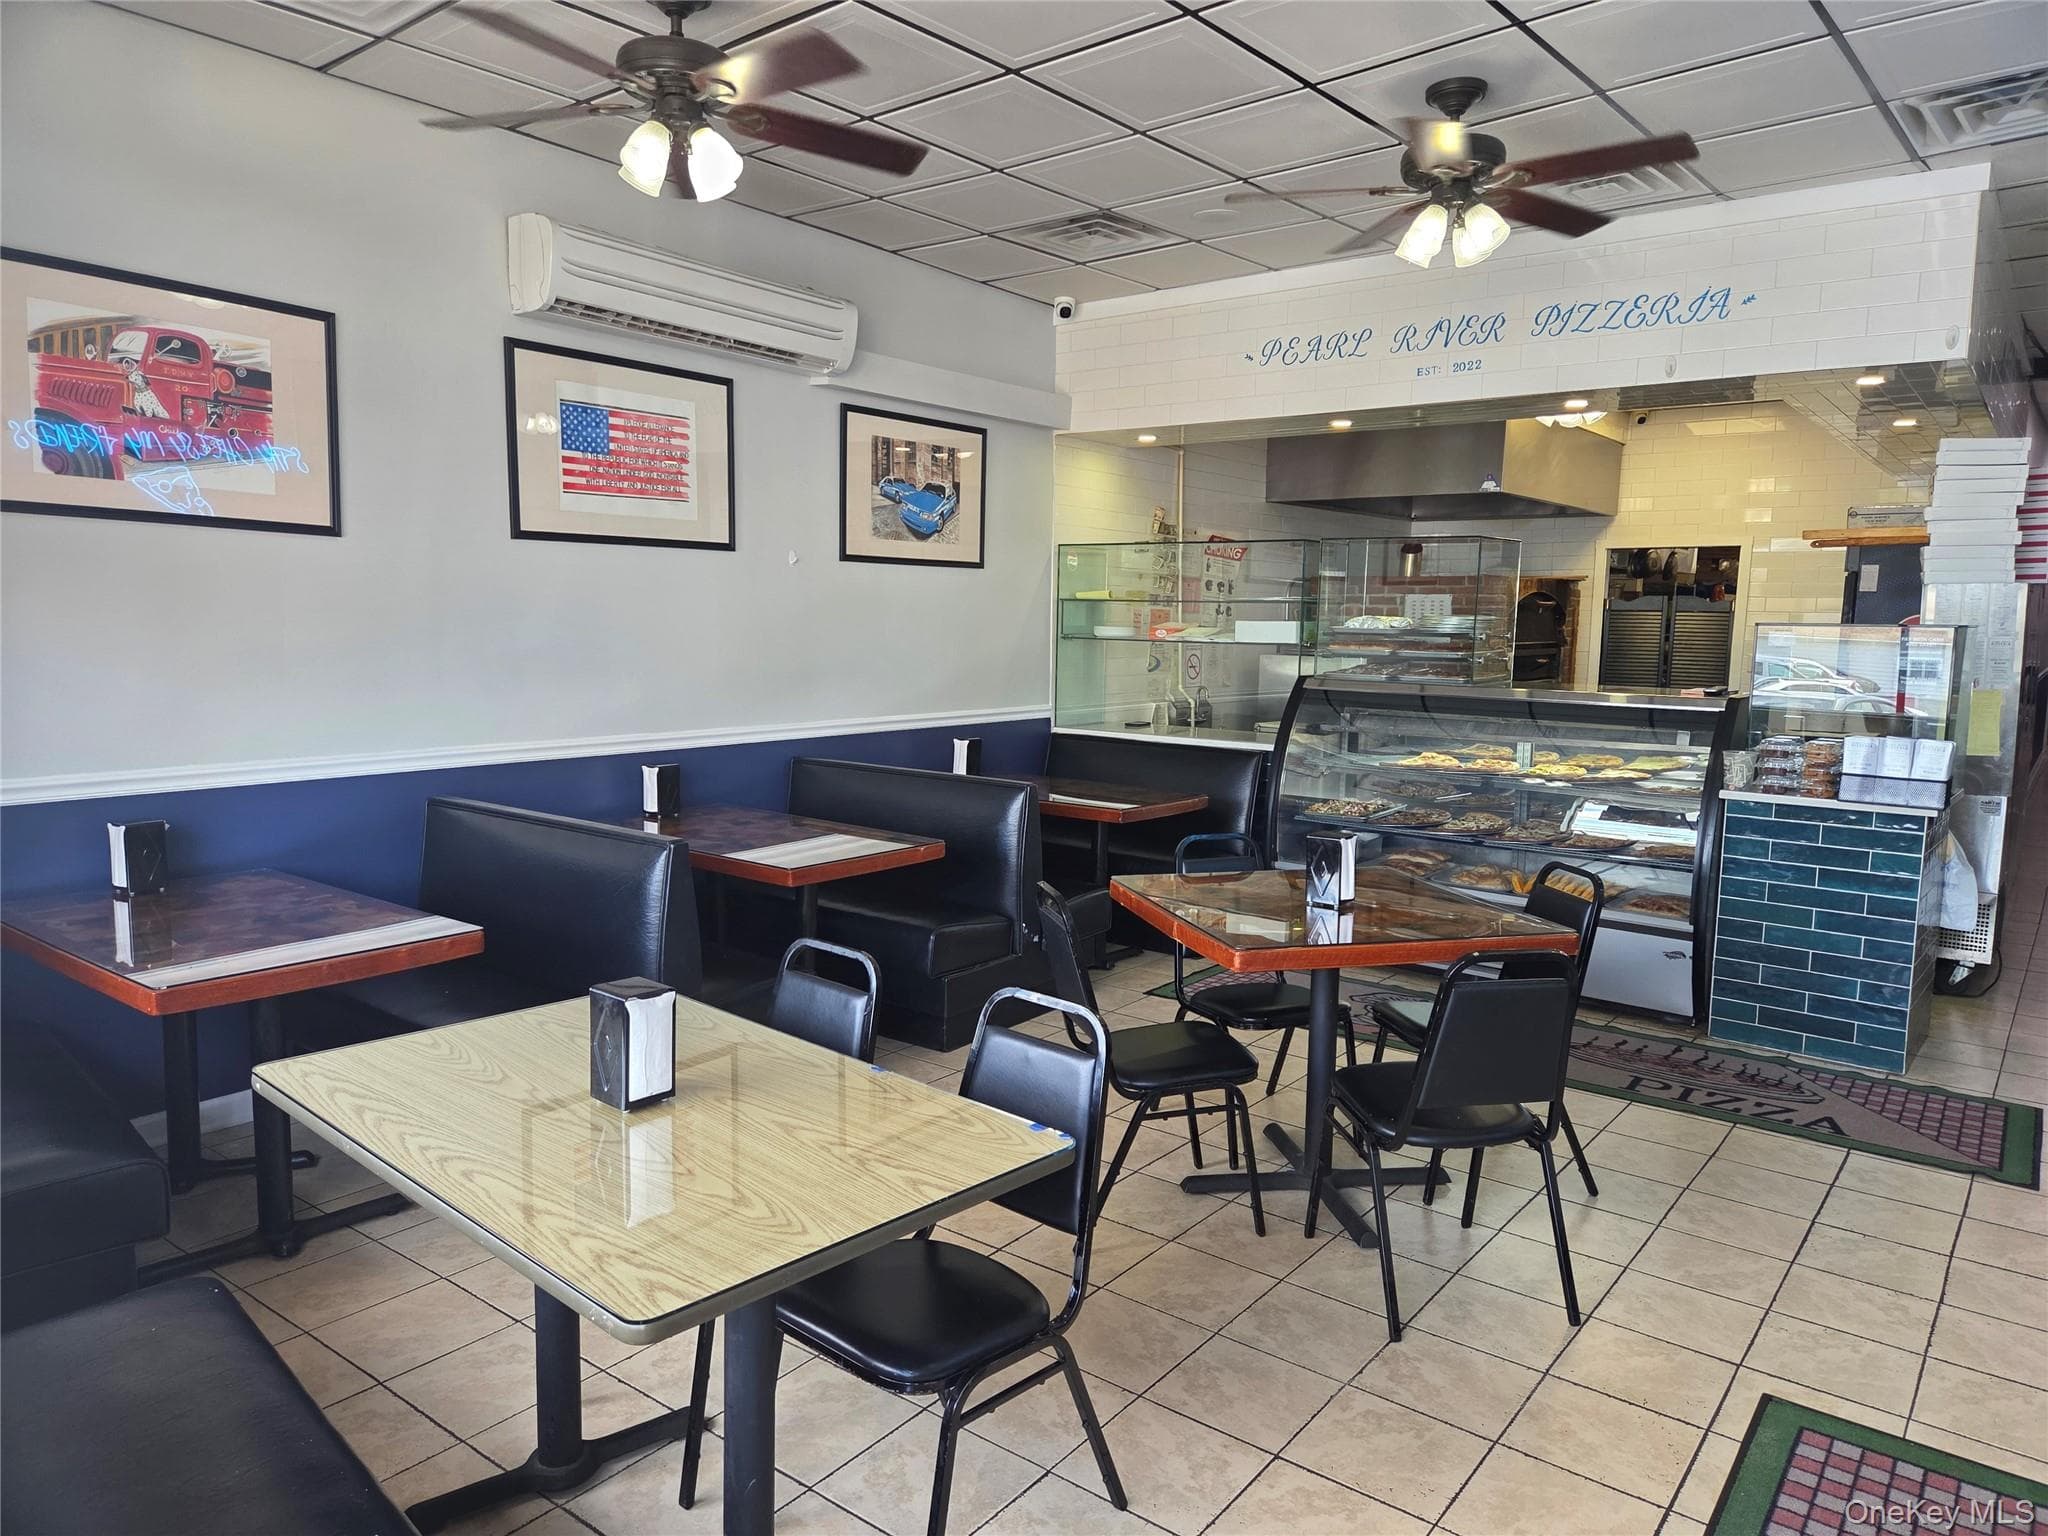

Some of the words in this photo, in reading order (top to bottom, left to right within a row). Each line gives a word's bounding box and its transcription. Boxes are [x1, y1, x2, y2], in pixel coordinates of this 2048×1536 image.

[1259, 328, 1373, 368] PEARL
[1390, 311, 1507, 355] RIVER
[1531, 286, 1733, 338] PIZZERIA
[1416, 366, 1442, 377] EST:
[1452, 359, 1483, 373] 2022
[1618, 1074, 1851, 1137] PIZZA
